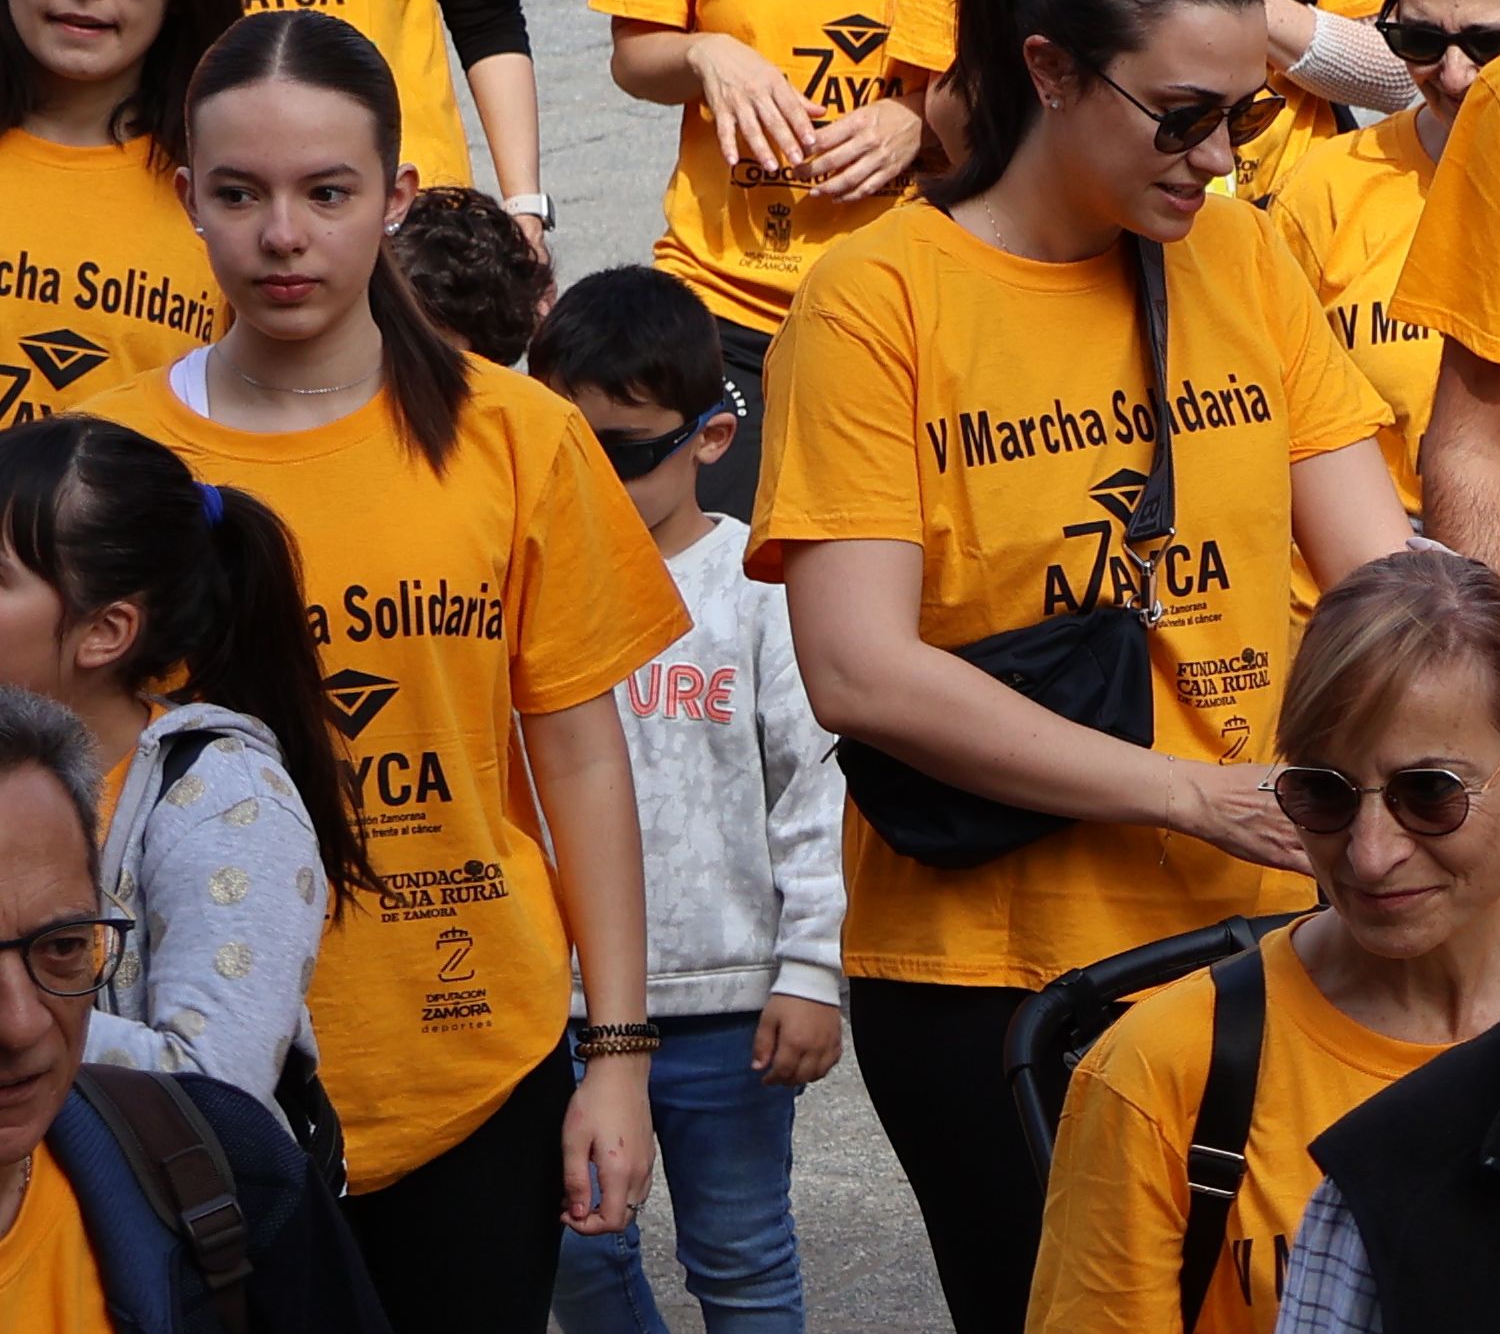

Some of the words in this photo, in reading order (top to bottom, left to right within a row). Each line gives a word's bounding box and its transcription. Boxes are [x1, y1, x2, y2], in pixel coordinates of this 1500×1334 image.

[78, 260, 216, 344] Solidaria
[1339, 305, 1357, 350] V
[925, 420, 949, 476] V
[958, 401, 1110, 463] Marcha
[344, 577, 503, 643] Solidaria
[626, 662, 738, 724] URE
[1176, 676, 1219, 699] CAJA
[1222, 669, 1271, 695] RURAL
[379, 884, 436, 912] CAJA
[439, 879, 509, 905] RURAL
[380, 913, 399, 923] DE
[401, 906, 459, 922] ZAMORA
[421, 1002, 492, 1022] ZAMORA
[421, 1017, 493, 1035] deportes
